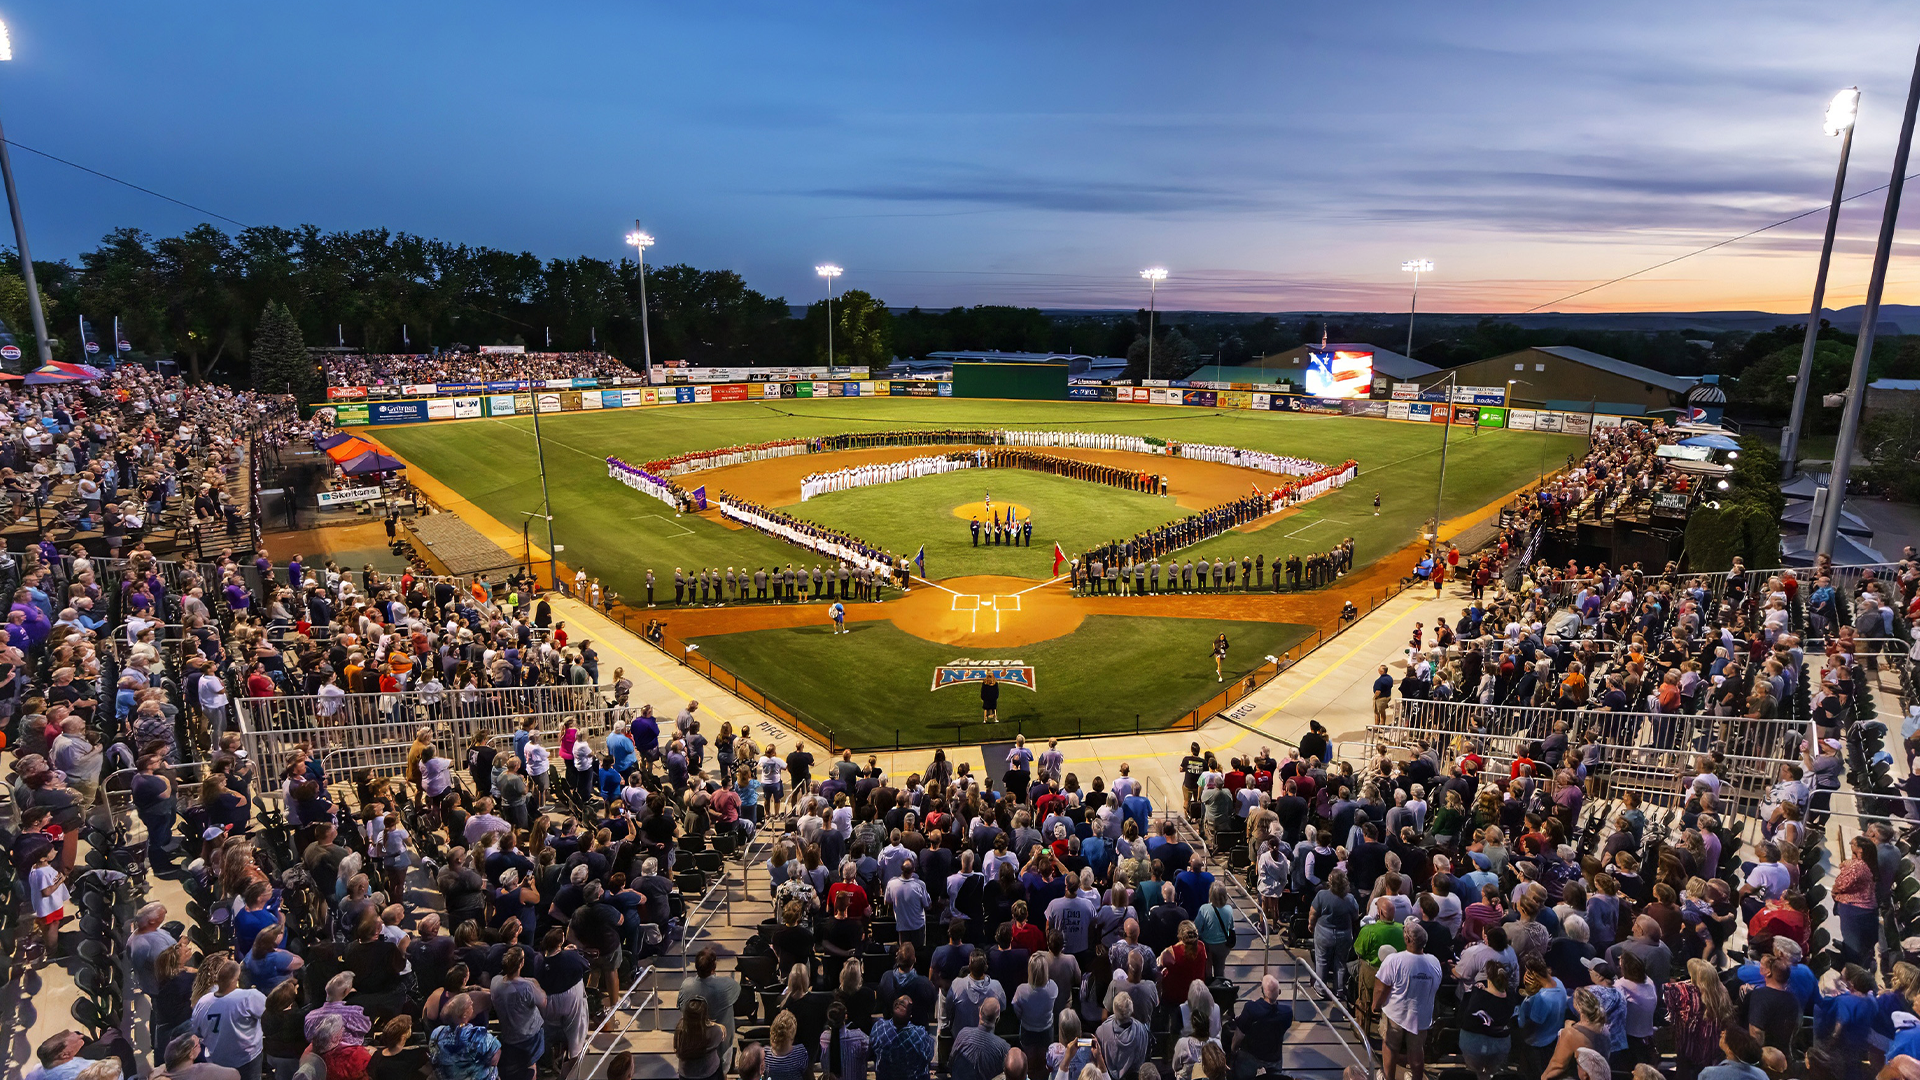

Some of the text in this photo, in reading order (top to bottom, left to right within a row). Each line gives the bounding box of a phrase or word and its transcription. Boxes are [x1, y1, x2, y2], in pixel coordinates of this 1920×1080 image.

[939, 669, 1028, 685] NAIA
[756, 721, 787, 739] P1FCU
[207, 1013, 221, 1033] 7
